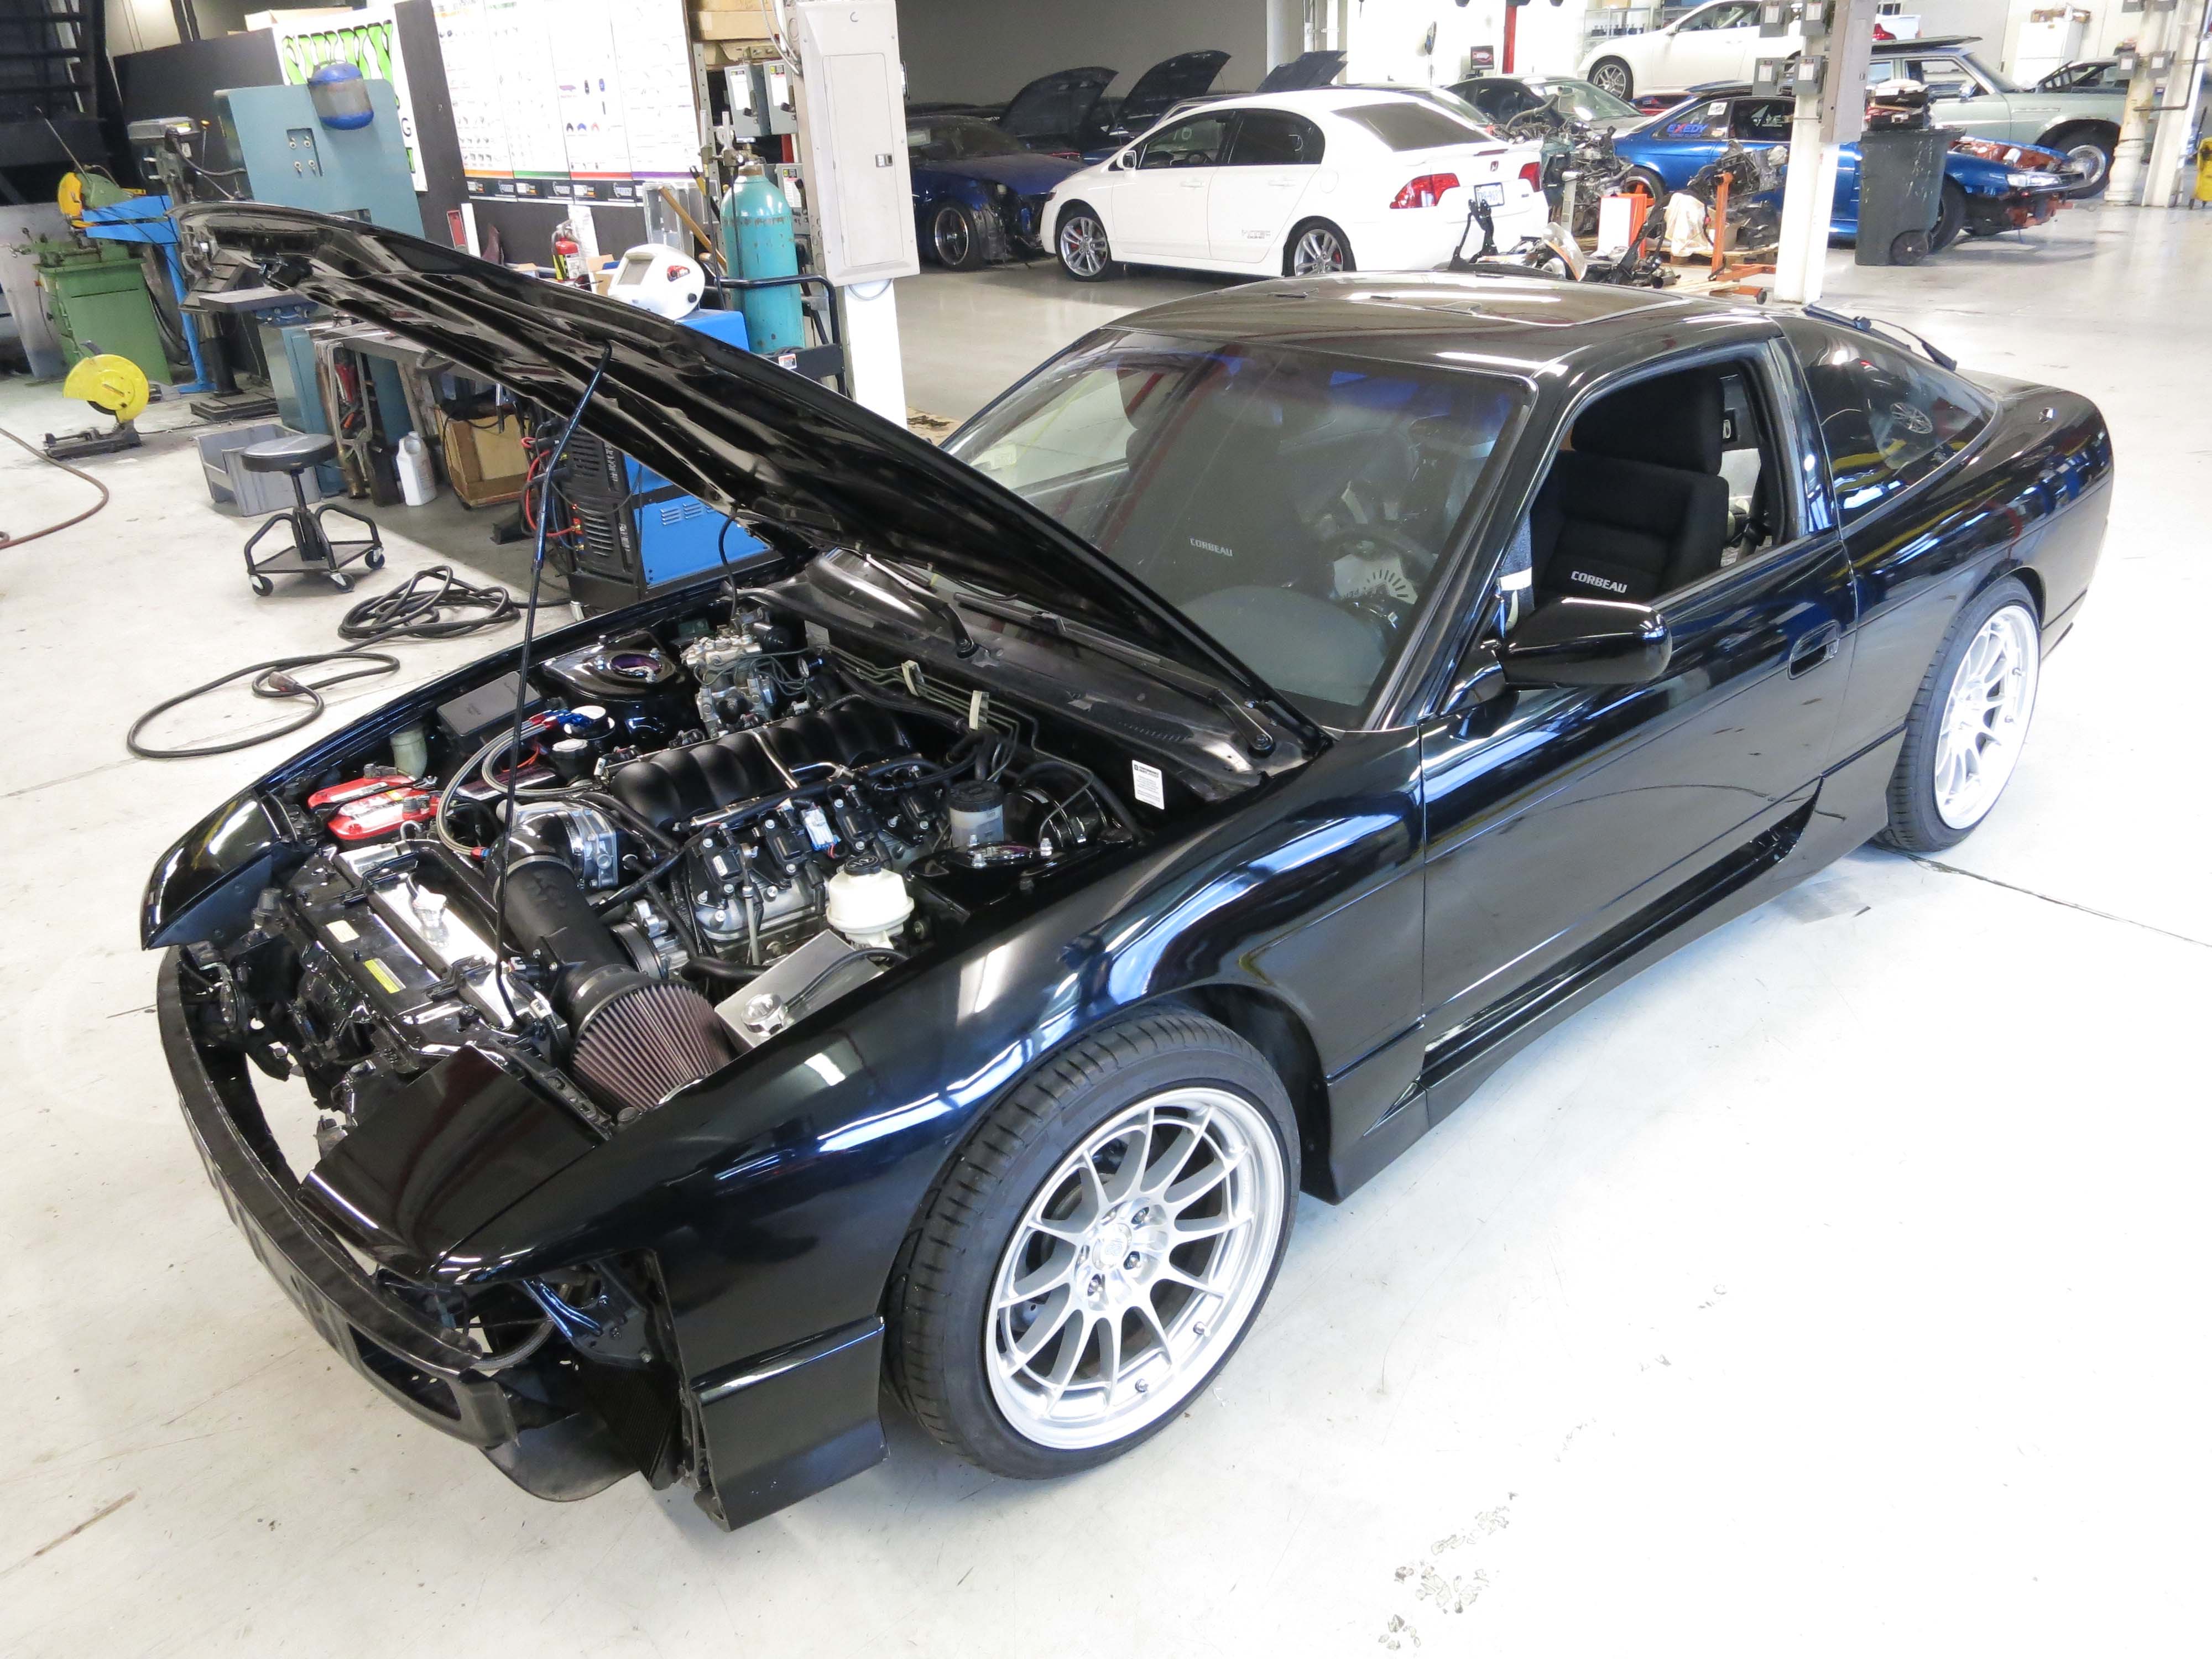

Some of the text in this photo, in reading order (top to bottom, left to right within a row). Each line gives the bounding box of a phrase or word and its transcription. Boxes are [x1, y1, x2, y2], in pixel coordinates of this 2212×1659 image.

[1667, 123, 1708, 133] EXEDY
[1190, 538, 1233, 557] CORBEAU
[1571, 571, 1627, 593] CORBEAU
